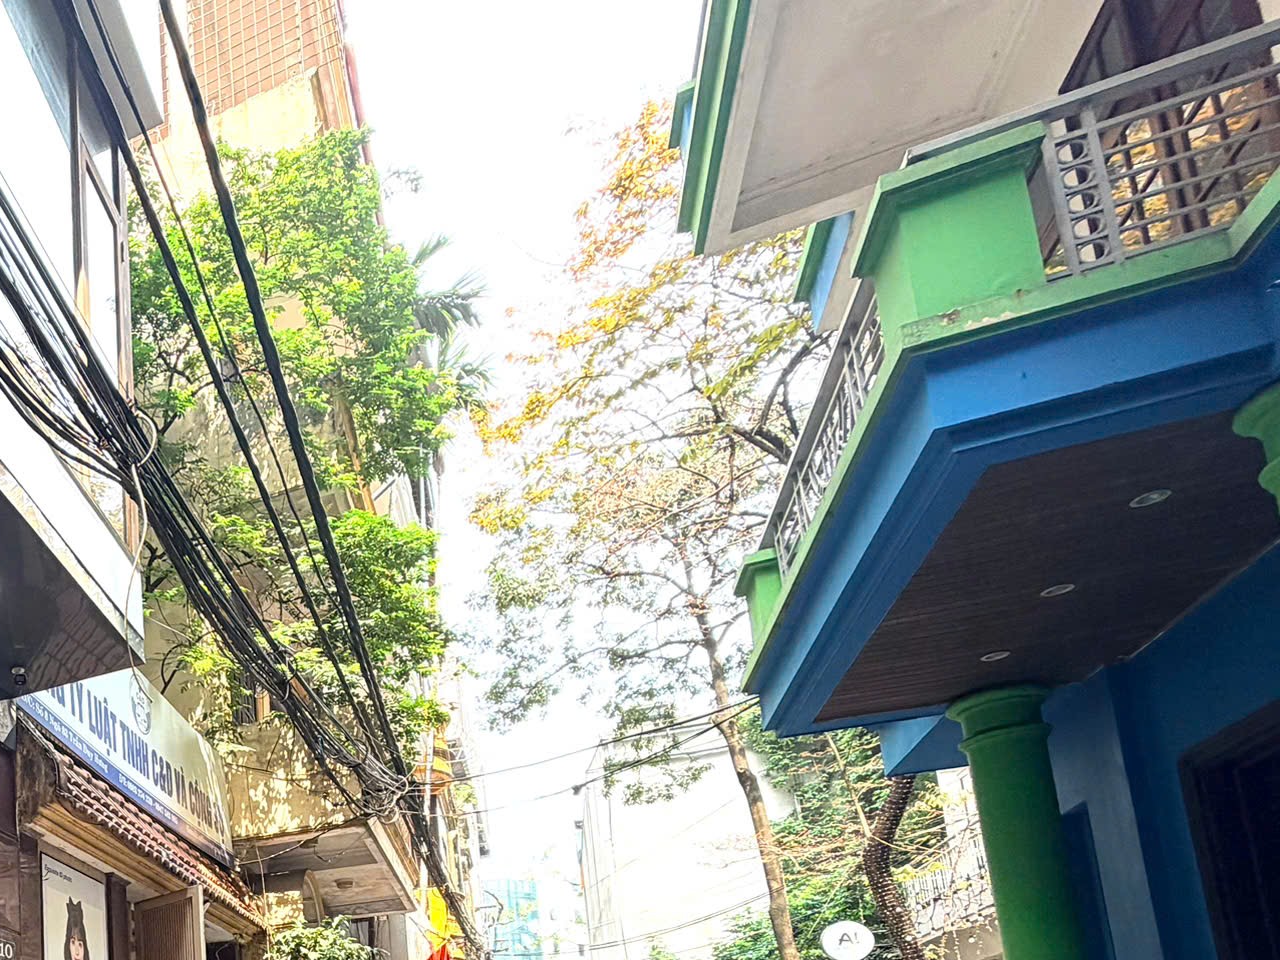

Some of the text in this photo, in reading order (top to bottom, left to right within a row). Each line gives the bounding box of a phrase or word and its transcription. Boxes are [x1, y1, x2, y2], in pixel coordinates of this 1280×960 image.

[87, 689, 117, 756] LUẬT
[119, 719, 150, 780] TNHH
[152, 749, 173, 798] C&D
[174, 766, 188, 810] VÀ
[0, 943, 13, 959] 10
